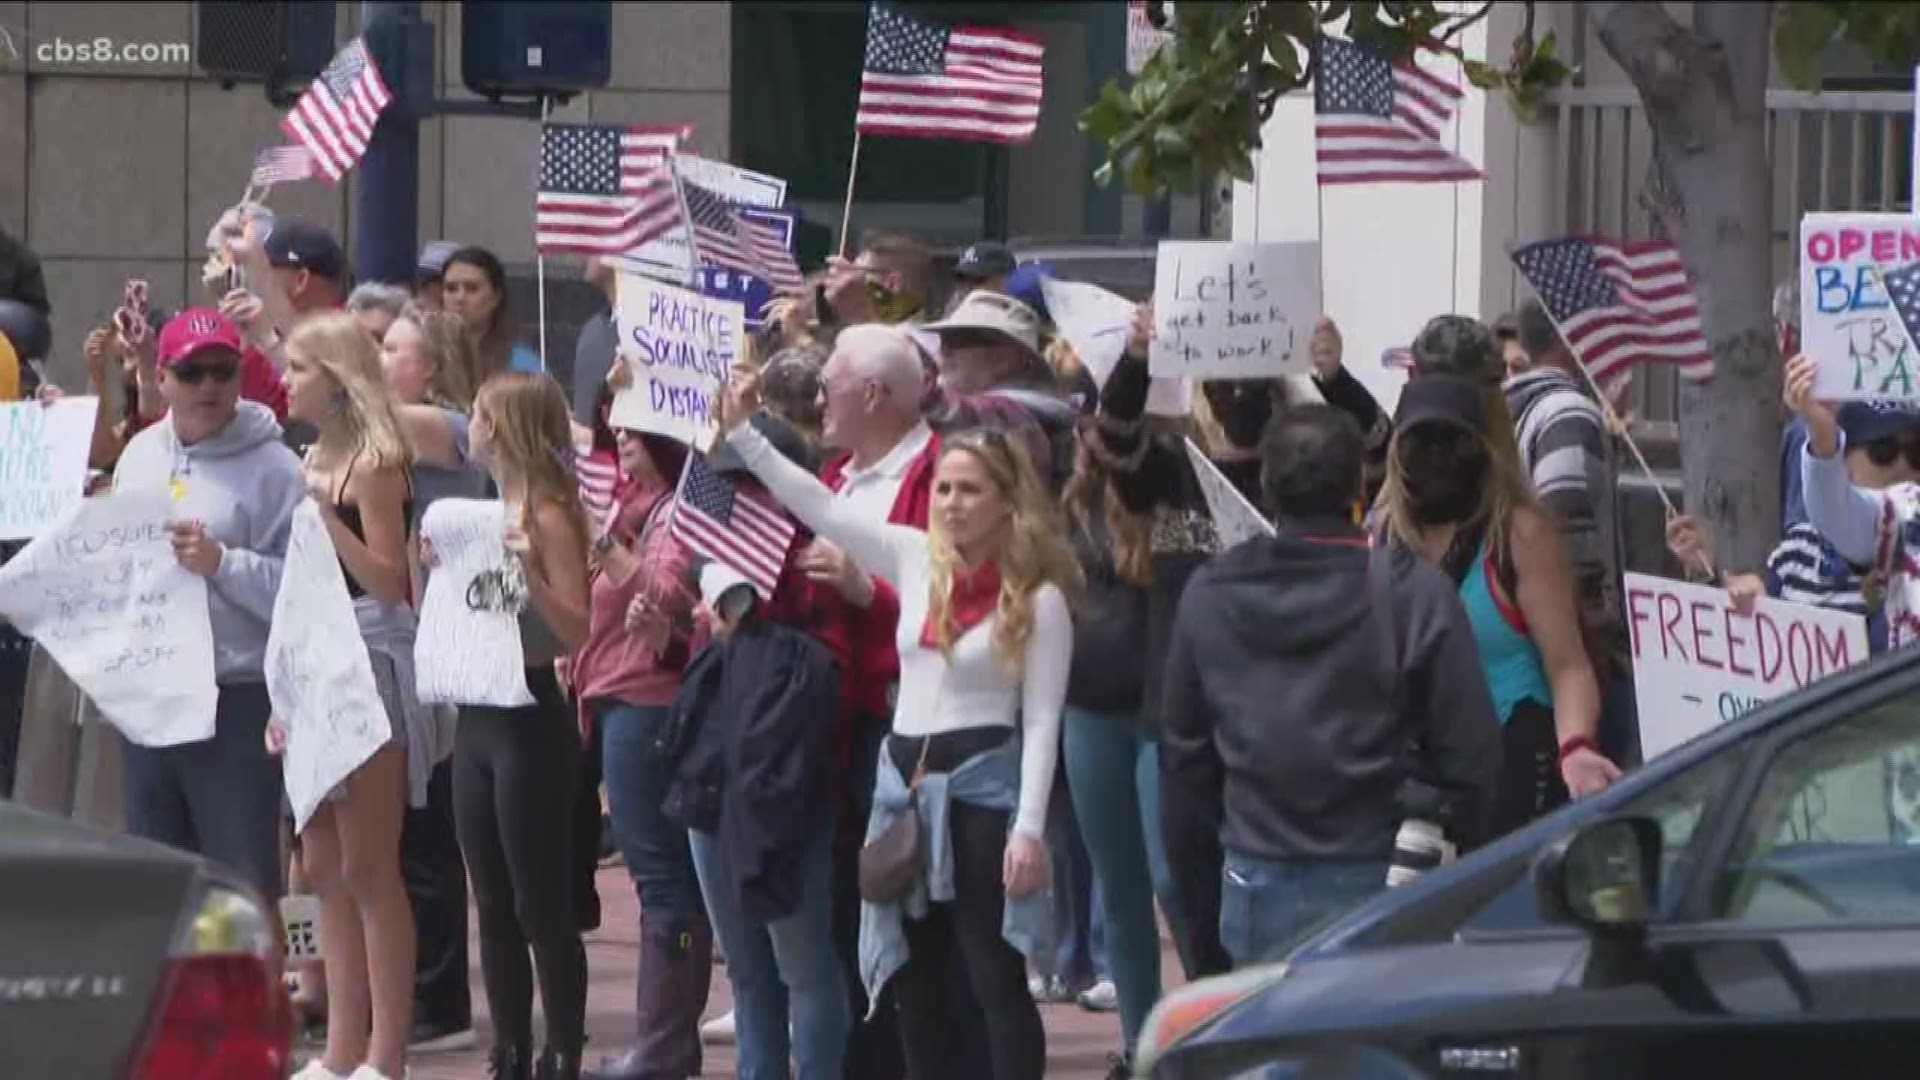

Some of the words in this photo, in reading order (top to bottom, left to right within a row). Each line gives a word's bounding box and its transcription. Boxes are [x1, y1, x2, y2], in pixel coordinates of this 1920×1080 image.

[1807, 228, 1920, 264] OPEN
[1173, 256, 1268, 302] Let's
[649, 291, 732, 347] PRACTICE
[1166, 308, 1207, 350] get
[1228, 305, 1288, 325] back
[632, 325, 734, 382] SOCIALIST
[1627, 587, 1850, 692] FREEDOM
